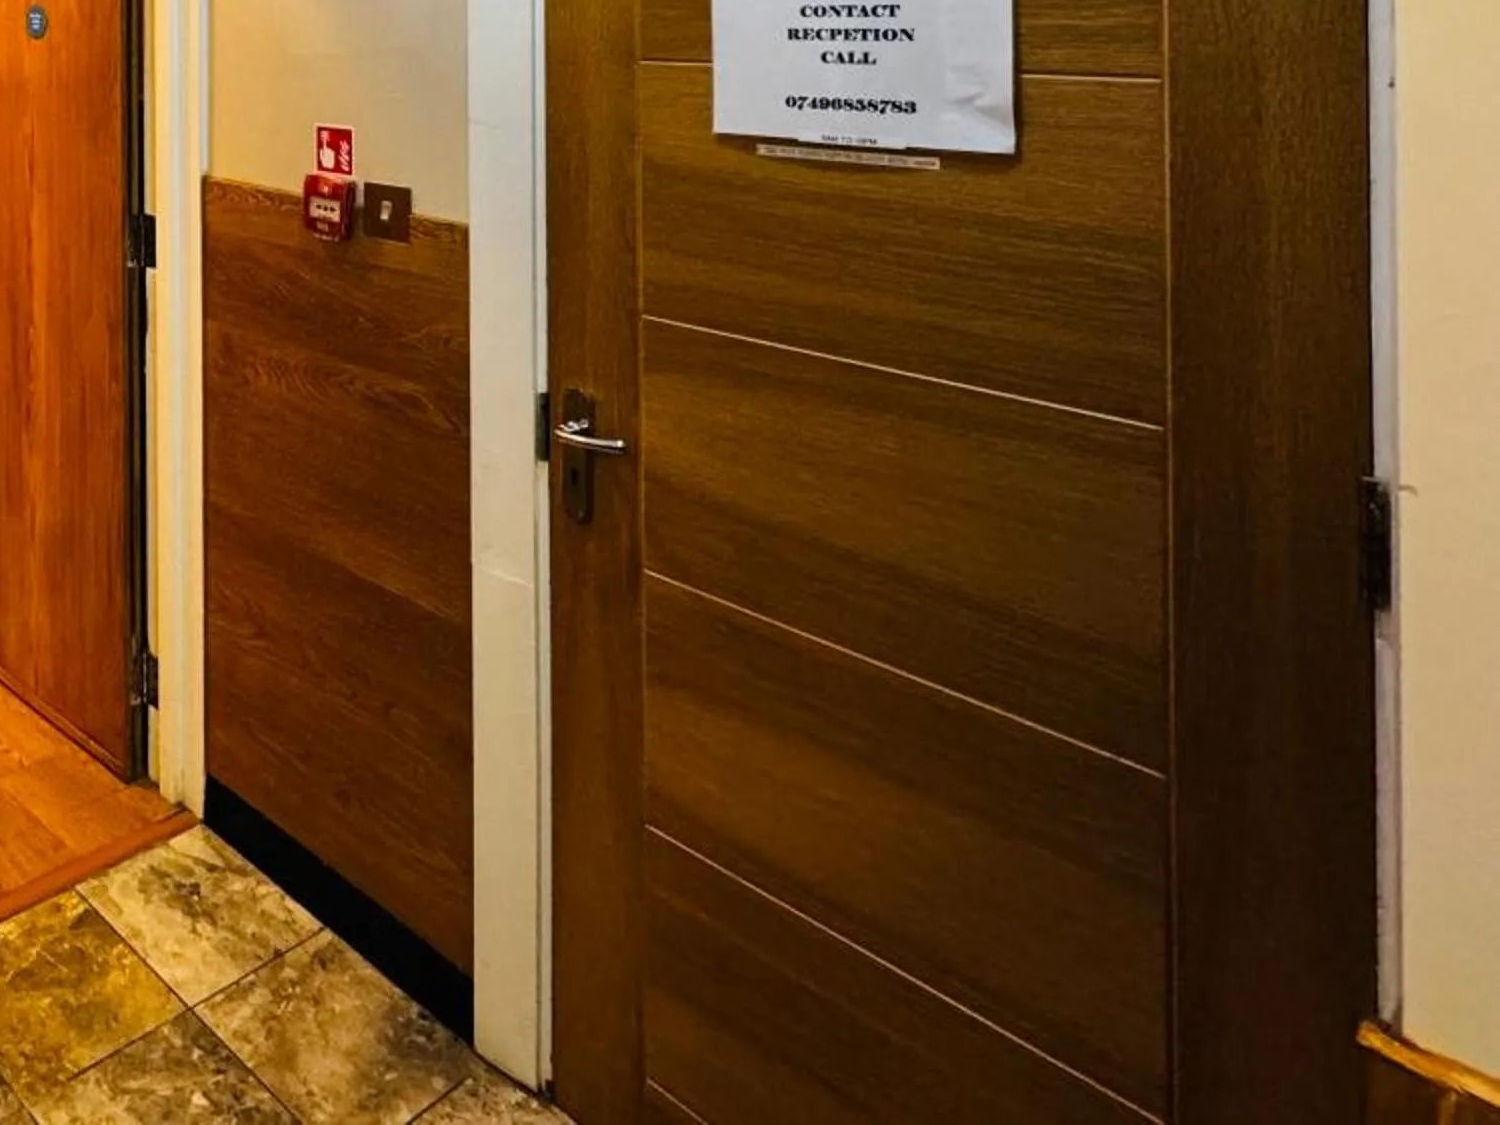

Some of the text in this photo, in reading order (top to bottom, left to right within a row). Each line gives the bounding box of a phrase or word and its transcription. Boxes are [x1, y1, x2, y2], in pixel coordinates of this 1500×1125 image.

[800, 4, 901, 19] CONTACT
[787, 27, 916, 43] RECPETION
[821, 51, 878, 66] CALL
